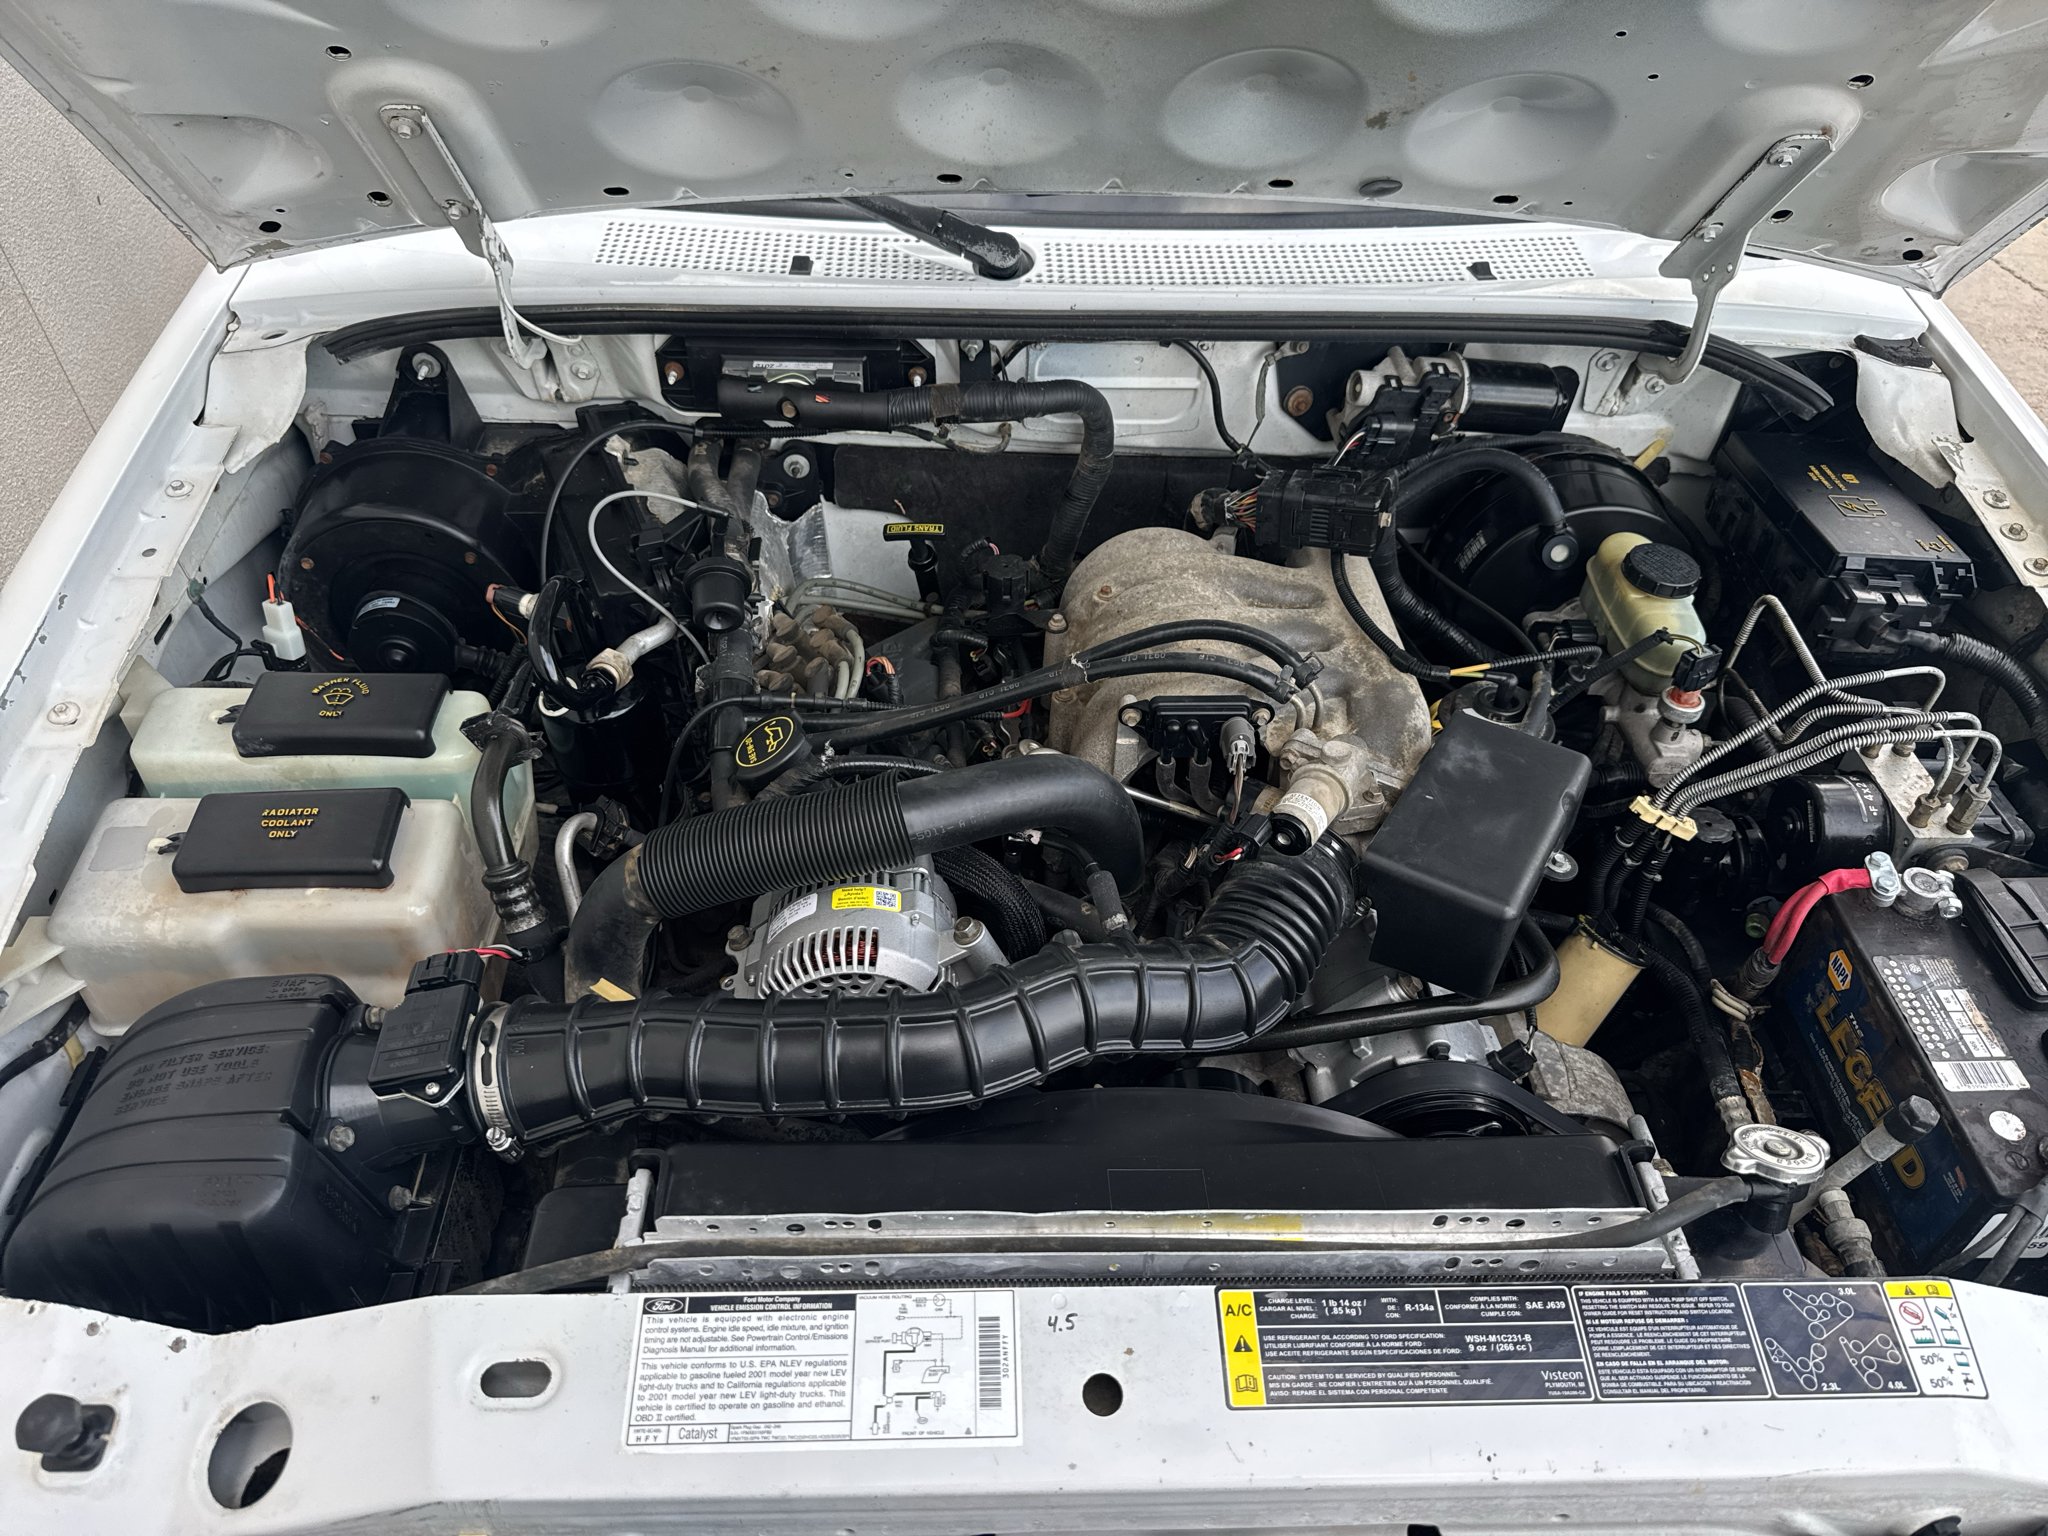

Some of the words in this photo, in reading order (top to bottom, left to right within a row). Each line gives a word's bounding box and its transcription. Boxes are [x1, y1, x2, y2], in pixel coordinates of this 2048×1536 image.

[312, 677, 350, 694] WASHER
[352, 678, 370, 694] FLUID
[262, 808, 319, 816] RADIATOR
[1831, 956, 1849, 987] NAPA
[1814, 992, 1926, 1190] LEGED
[1838, 1287, 1856, 1296] 3.0L
[652, 1300, 676, 1311] Ford
[1225, 1304, 1252, 1316] A/C
[1525, 1301, 1544, 1310] SAE
[1345, 1307, 1356, 1316] kg
[714, 1315, 752, 1323] equipped
[822, 1313, 849, 1321] engine
[1048, 1313, 1078, 1332] 4.5
[670, 1326, 700, 1334] systems.
[702, 1325, 727, 1334] Engine
[742, 1325, 765, 1333] speed,
[824, 1323, 848, 1332] ignition
[644, 1336, 665, 1345] timing
[692, 1335, 729, 1344] adjustable.
[747, 1333, 783, 1341] Powertrain
[1464, 1334, 1532, 1343] WSH-M1C231-B
[643, 1346, 678, 1355] Diagnosis
[805, 1359, 847, 1368] regulations
[1920, 1354, 1944, 1365] 50%
[689, 1372, 720, 1380] gasoline
[1541, 1370, 1584, 1380] Visteon
[638, 1383, 674, 1392] light-duty
[765, 1380, 806, 1389] regulations
[808, 1380, 846, 1388] applicable
[1820, 1382, 1841, 1391] 2.3L
[1887, 1381, 1907, 1390] 4.0L
[1930, 1377, 1954, 1388] 50%
[699, 1393, 717, 1401] year
[760, 1391, 796, 1400] light-duty
[718, 1402, 748, 1411] operate
[762, 1401, 795, 1410] gasoline
[635, 1414, 654, 1422] OBD
[664, 1413, 696, 1421] certified.
[678, 1427, 718, 1442] Catalyst
